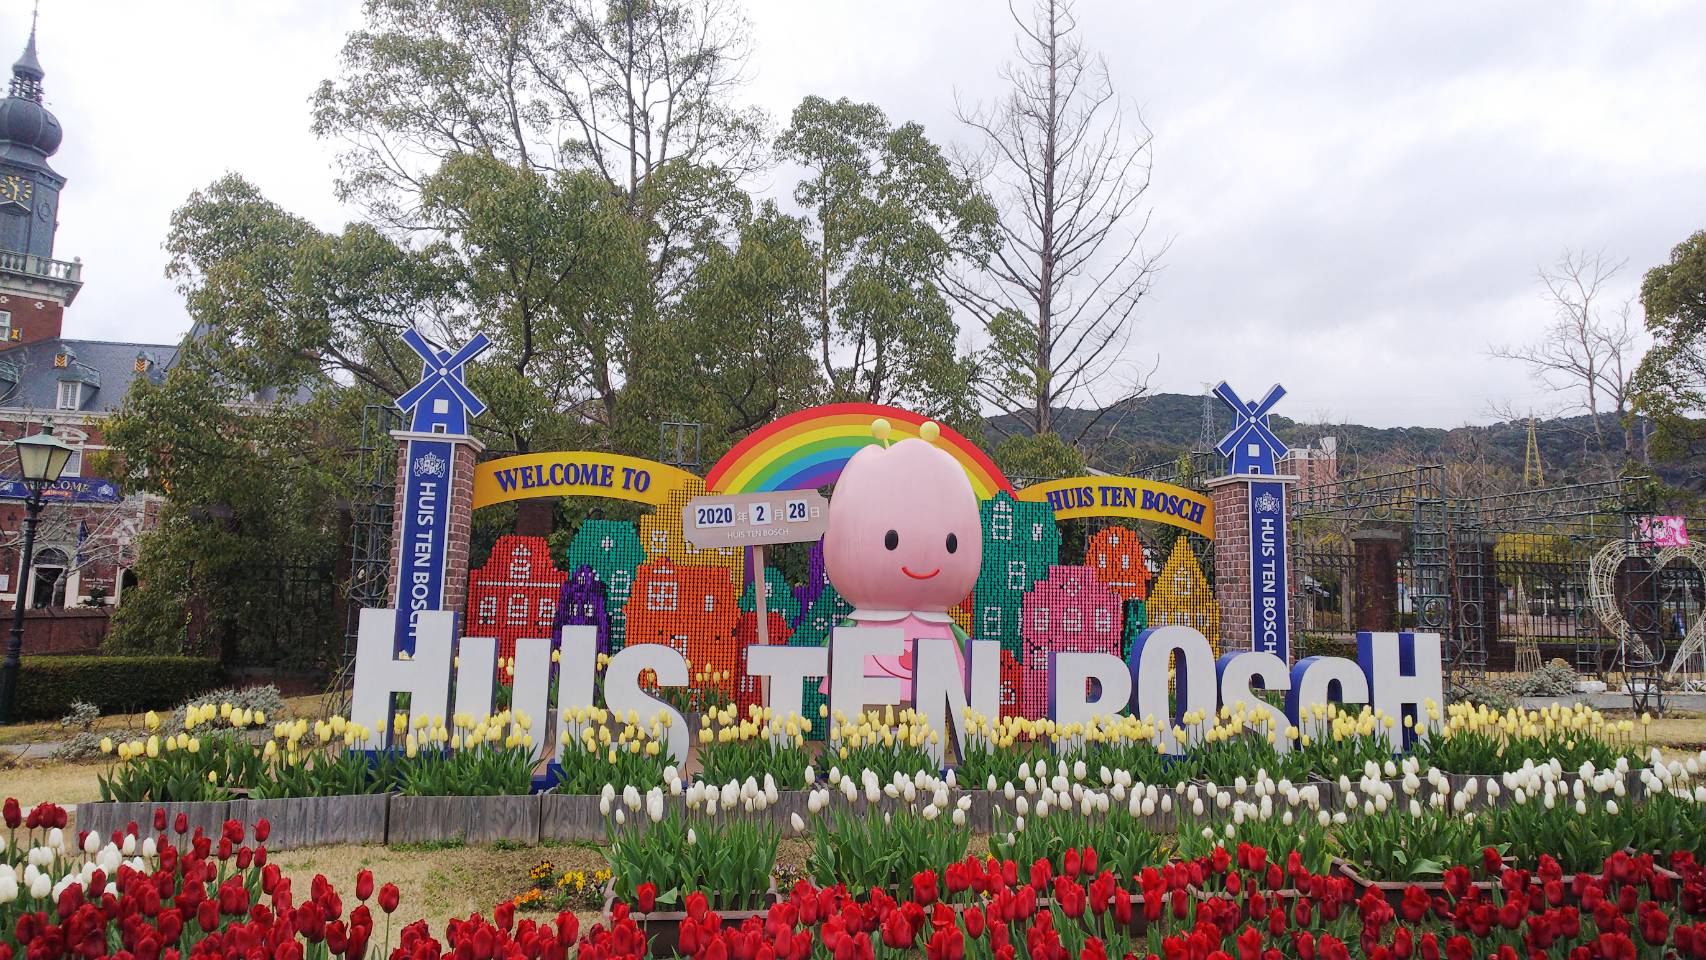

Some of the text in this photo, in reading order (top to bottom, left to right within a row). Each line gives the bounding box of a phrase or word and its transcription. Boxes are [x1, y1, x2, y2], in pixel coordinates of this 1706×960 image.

[23, 480, 90, 492] WLCOME
[494, 463, 651, 493] WELCOME TO
[417, 482, 437, 526] HUIS
[698, 507, 733, 525] 2020
[789, 502, 806, 519] 28
[1046, 486, 1207, 525] HUIS TEN BOSCH
[414, 530, 433, 567] TEN
[727, 528, 789, 539] HUIS TEN BOSCH
[1261, 518, 1277, 655] HUIS TEN BOSCH
[351, 608, 1443, 775] HUIS TEN BOSCH
